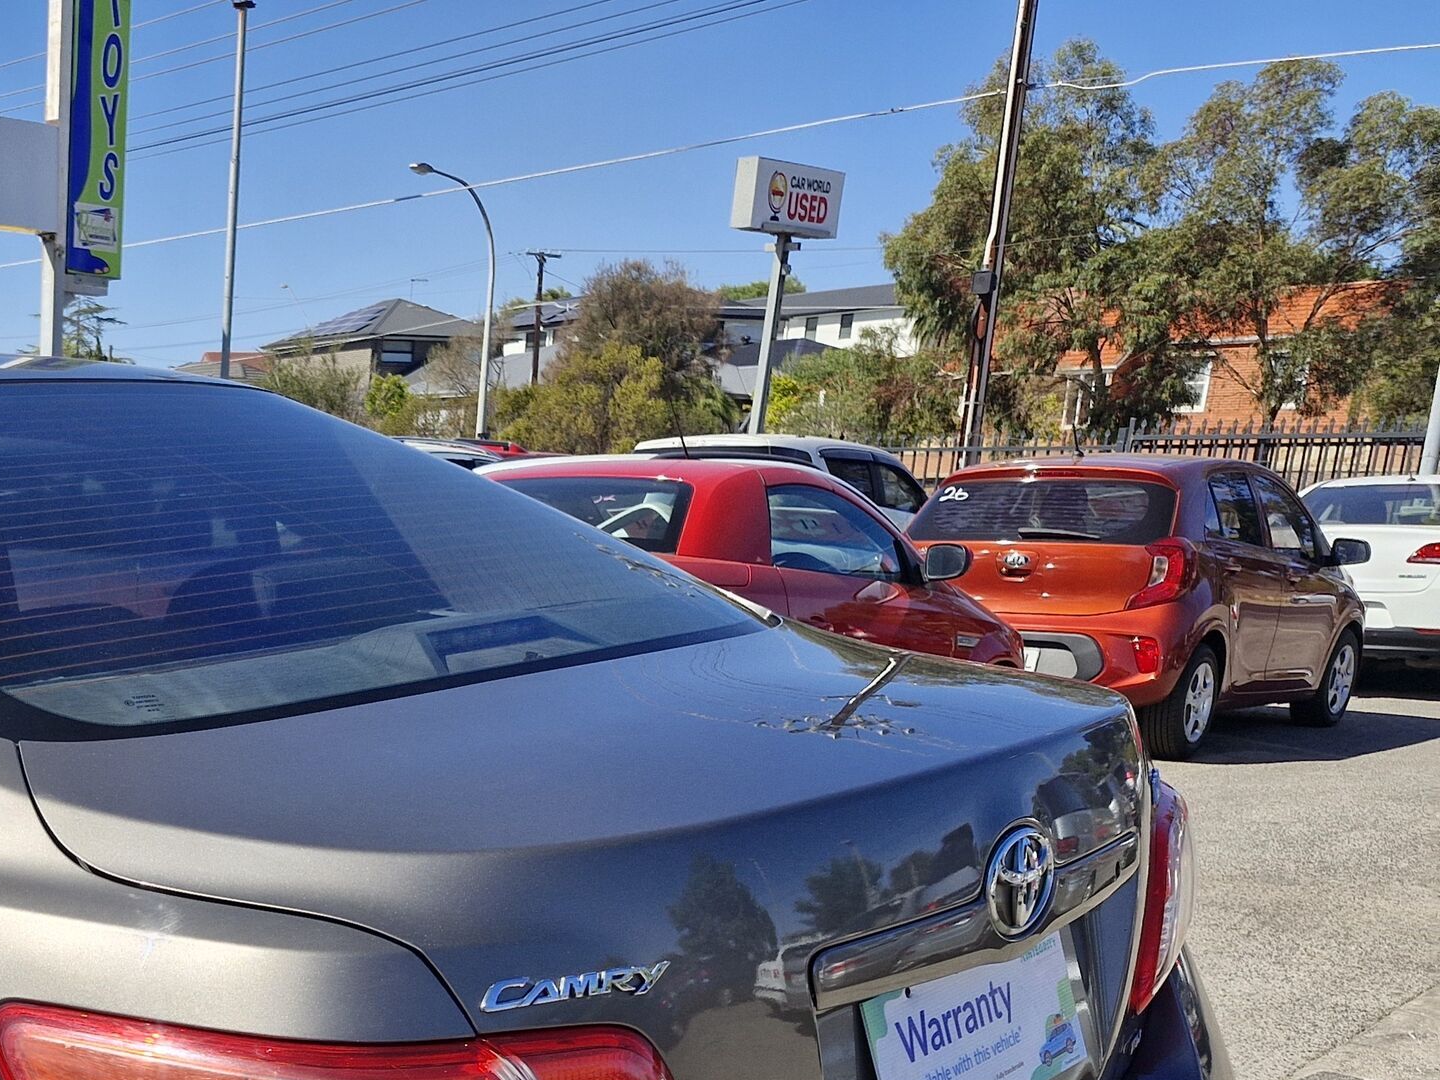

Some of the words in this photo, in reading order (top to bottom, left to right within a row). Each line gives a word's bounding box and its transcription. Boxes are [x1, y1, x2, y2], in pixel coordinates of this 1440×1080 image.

[790, 175, 806, 190] CAR
[807, 178, 832, 194] WORLD
[786, 191, 829, 224] USED
[939, 486, 969, 502] 26
[479, 960, 671, 1013] CAMRY
[894, 981, 1012, 1063] Warranty
[952, 1052, 974, 1076] with
[974, 1045, 992, 1065] this
